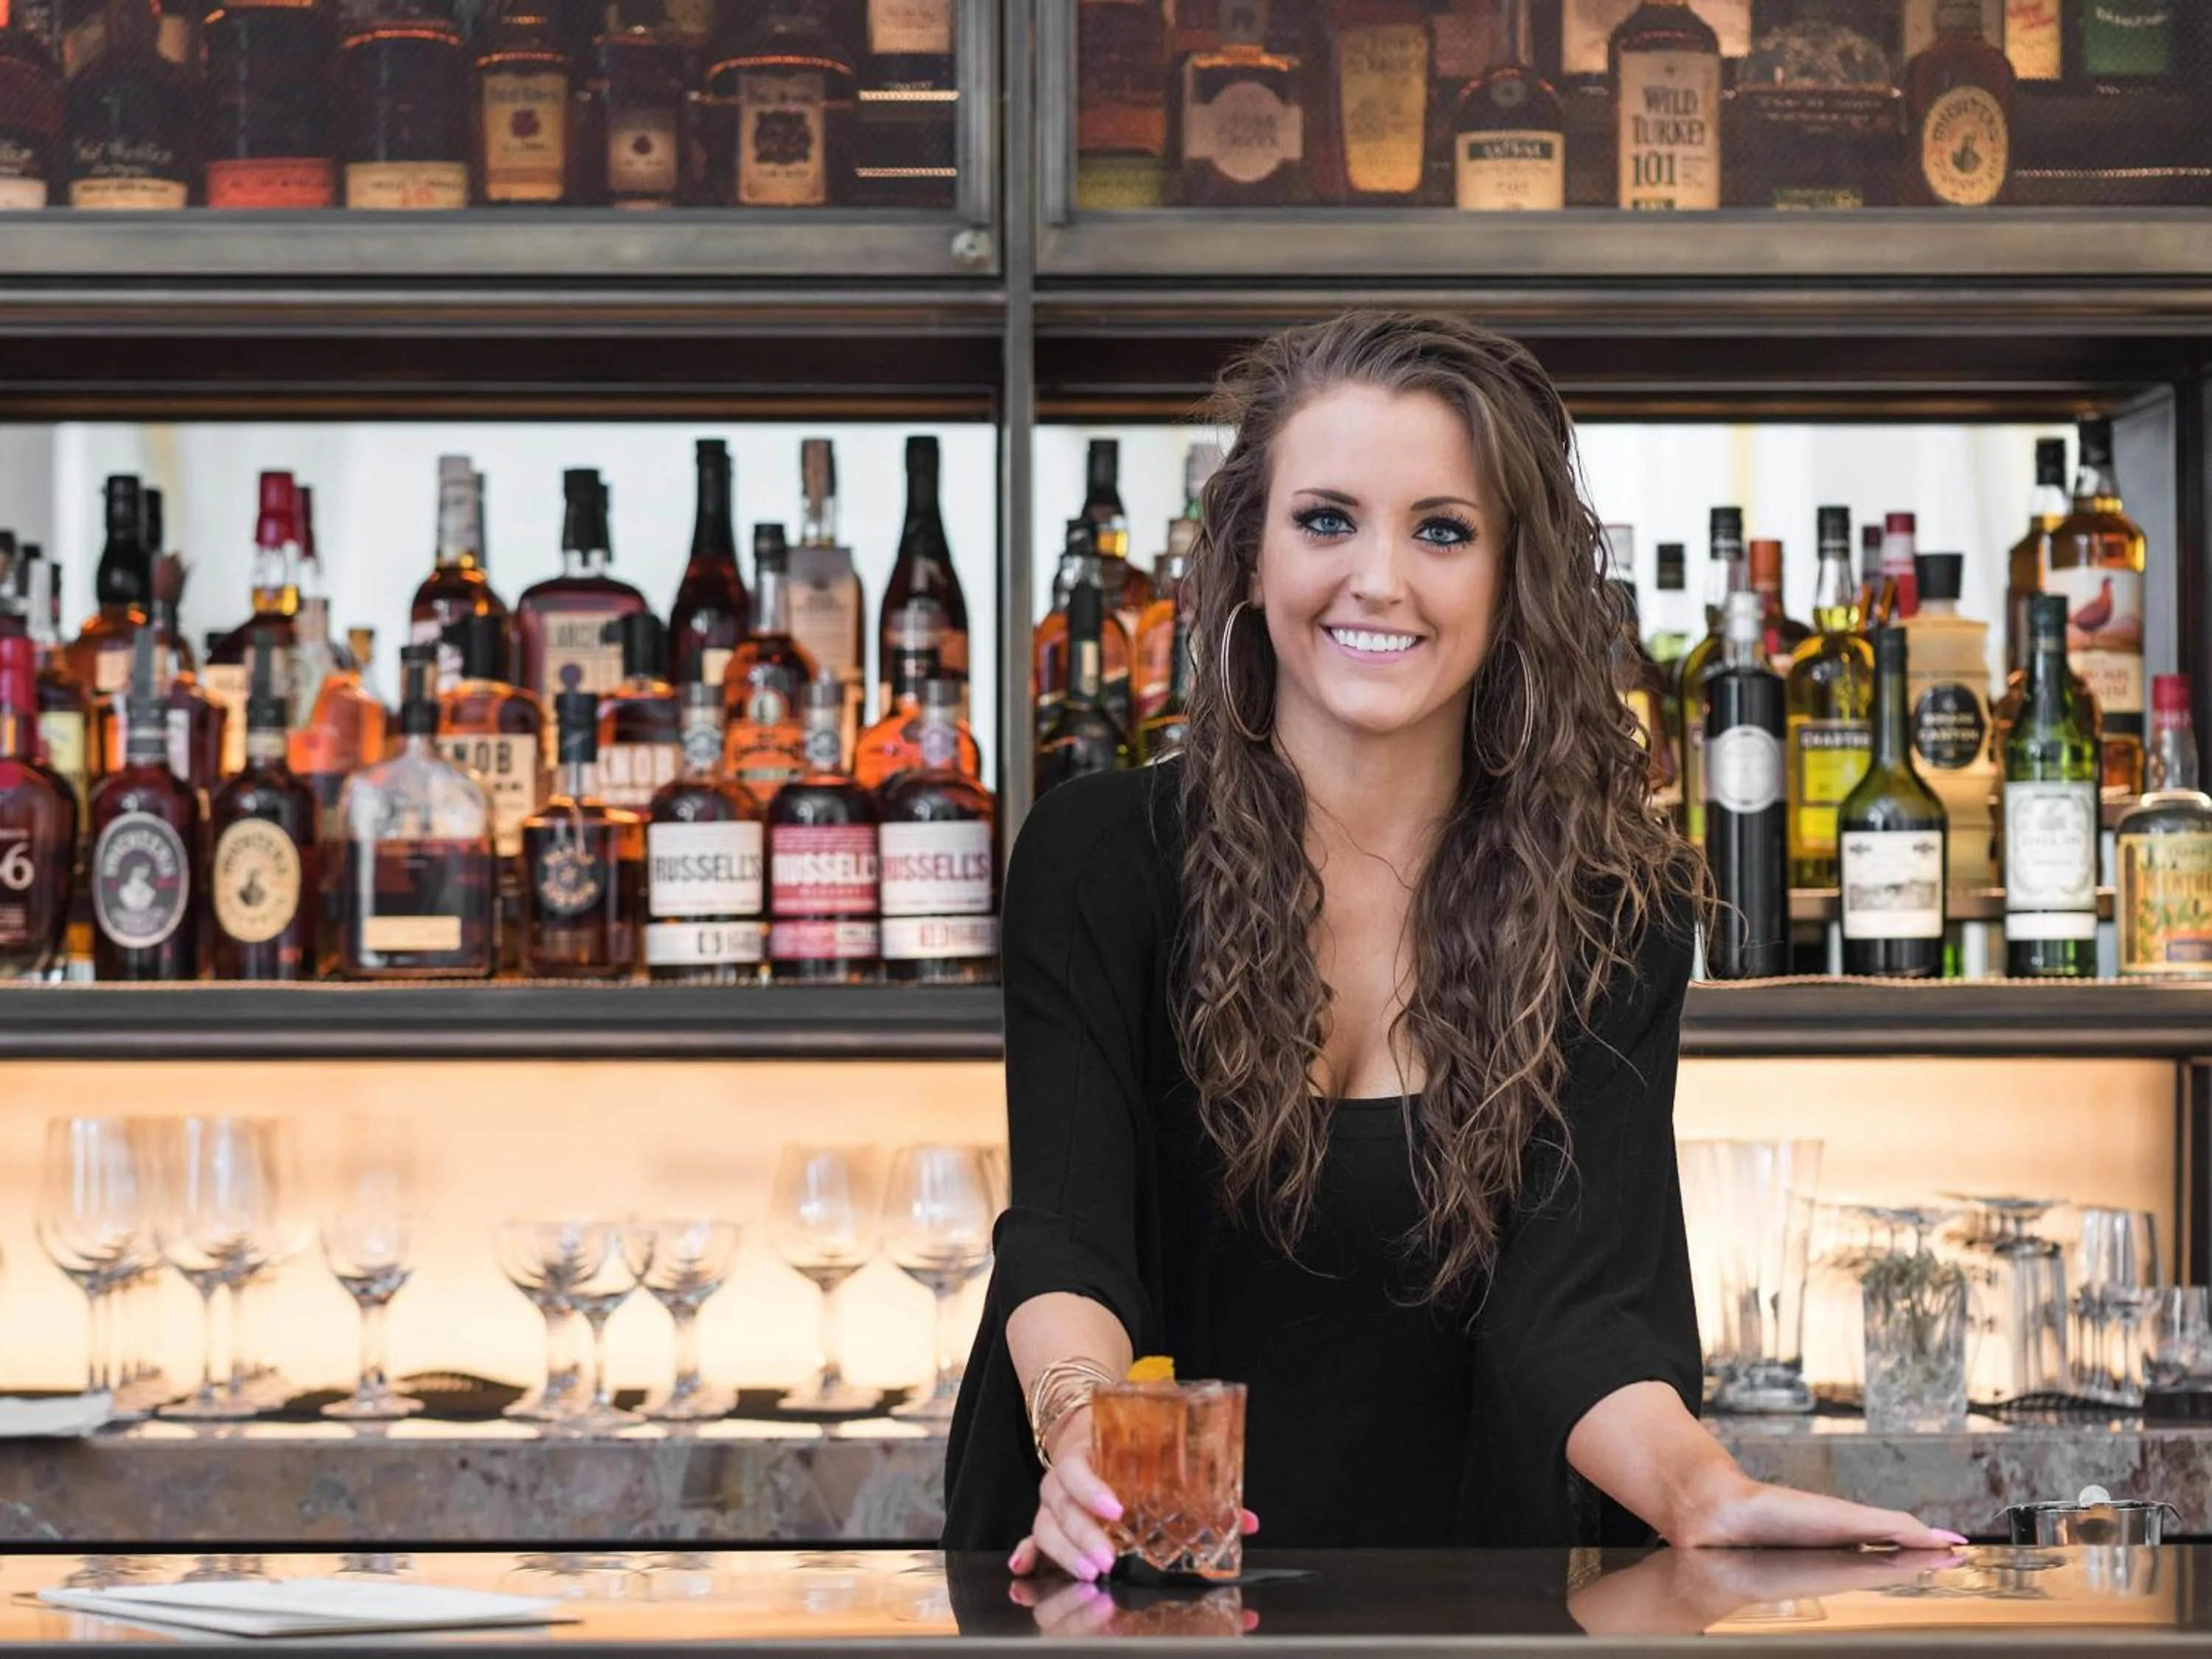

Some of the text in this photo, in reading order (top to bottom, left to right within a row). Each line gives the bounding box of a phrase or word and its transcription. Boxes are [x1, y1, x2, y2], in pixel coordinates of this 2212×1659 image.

[1643, 87, 1698, 115] WILD
[1632, 115, 1706, 145] TURKEY
[1632, 152, 1675, 187] 101
[0, 841, 35, 891] 6
